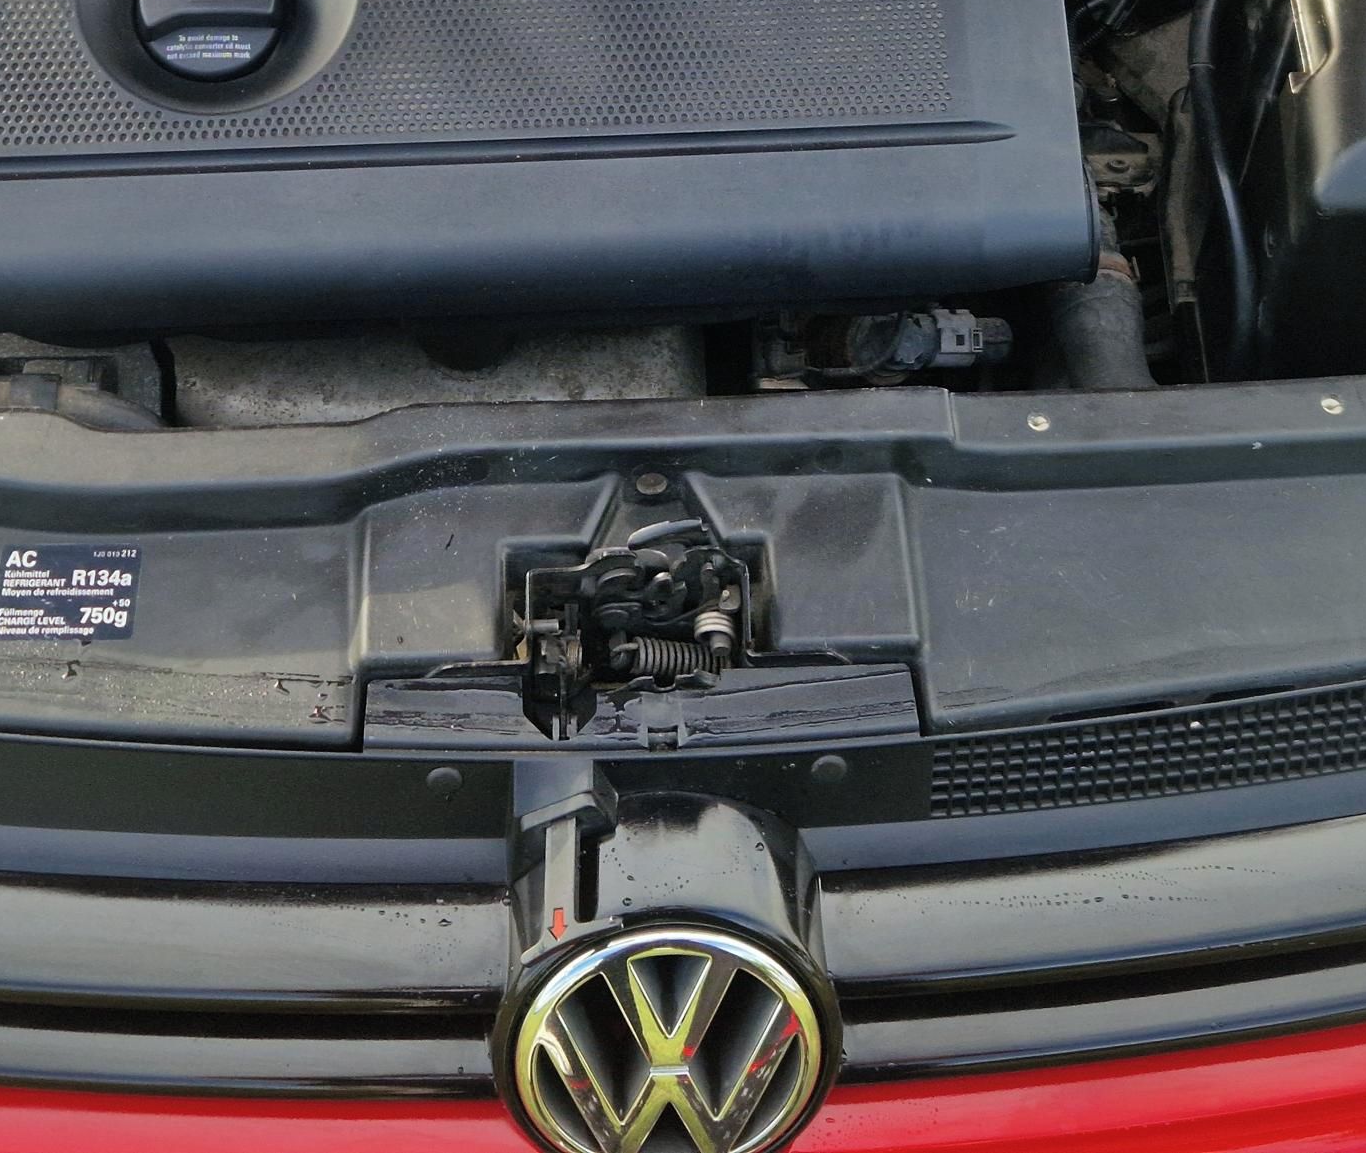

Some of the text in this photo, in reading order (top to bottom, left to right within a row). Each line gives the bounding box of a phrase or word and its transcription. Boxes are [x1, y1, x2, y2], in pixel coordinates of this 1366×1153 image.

[121, 549, 136, 558] 212
[6, 550, 37, 567] AC
[4, 570, 50, 578] Kühlmittel
[72, 569, 132, 586] R134a
[3, 579, 66, 587] REFRIGERANT
[2, 588, 31, 597] Moyen
[80, 607, 128, 627] 750g
[41, 627, 94, 636] remplissage
